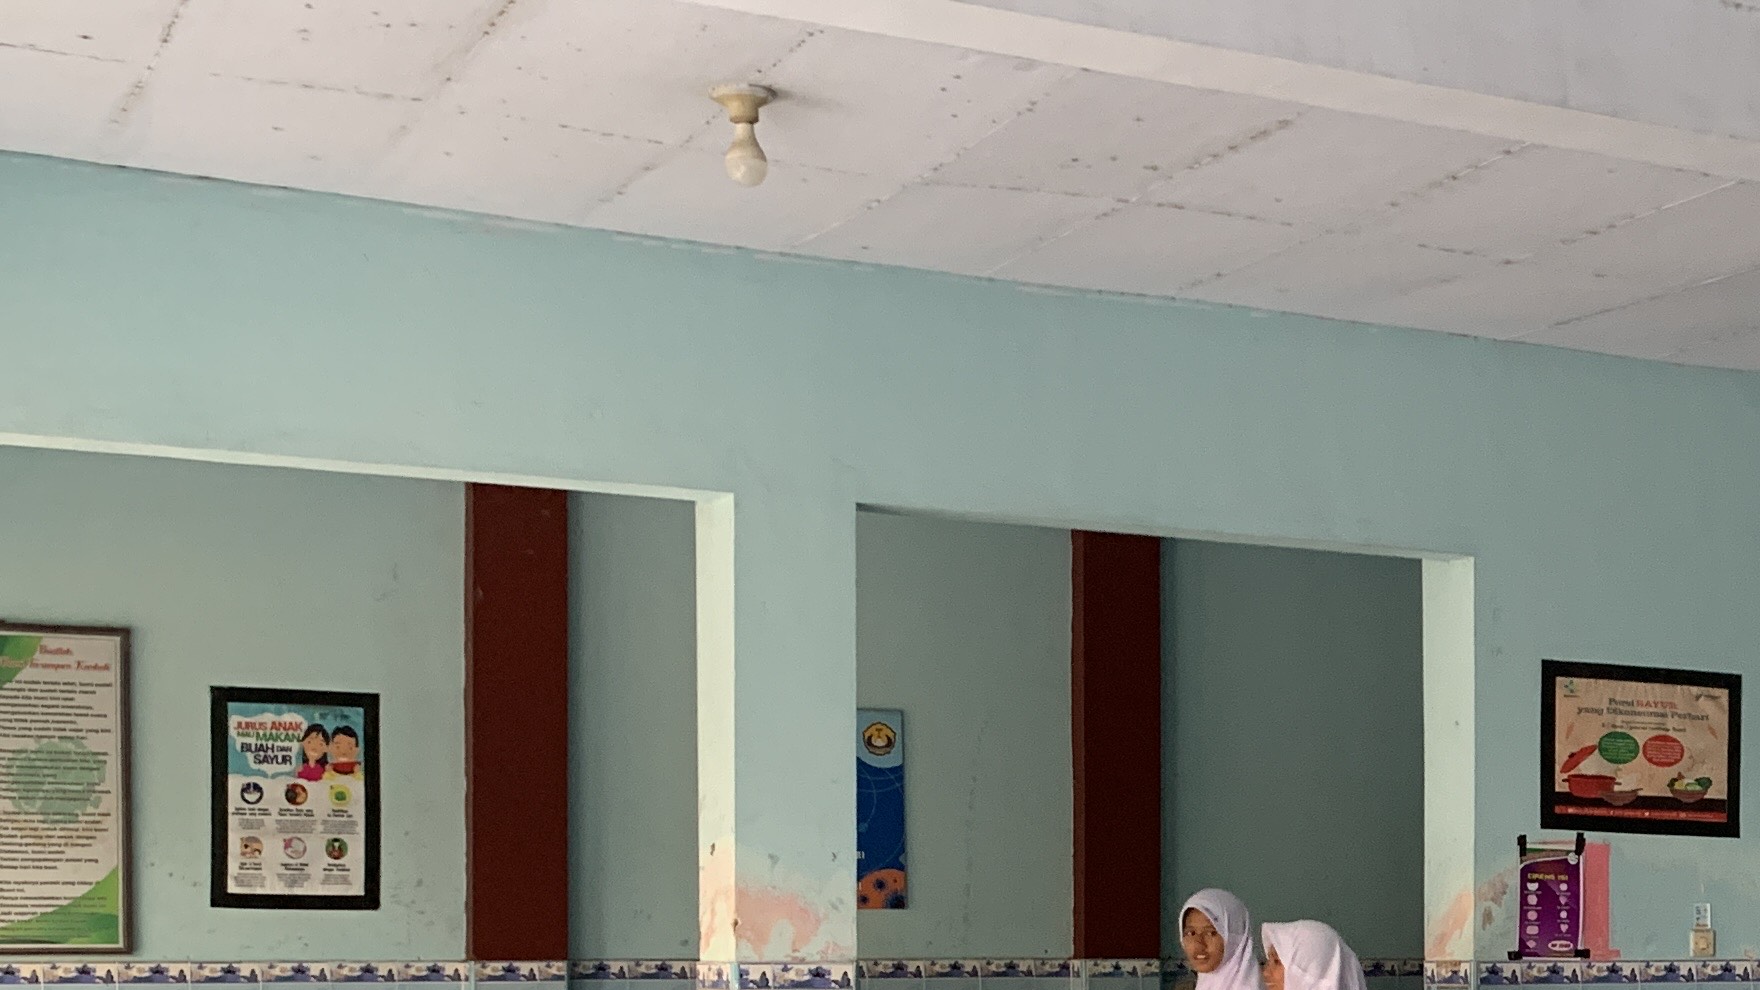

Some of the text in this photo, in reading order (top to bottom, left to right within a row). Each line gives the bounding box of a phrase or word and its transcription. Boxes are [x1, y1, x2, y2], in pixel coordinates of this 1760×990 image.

[234, 721, 303, 732] JURUS ANAK
[255, 731, 302, 743] MAKAN
[241, 742, 275, 754] BUAH
[253, 754, 293, 766] SAYUR
